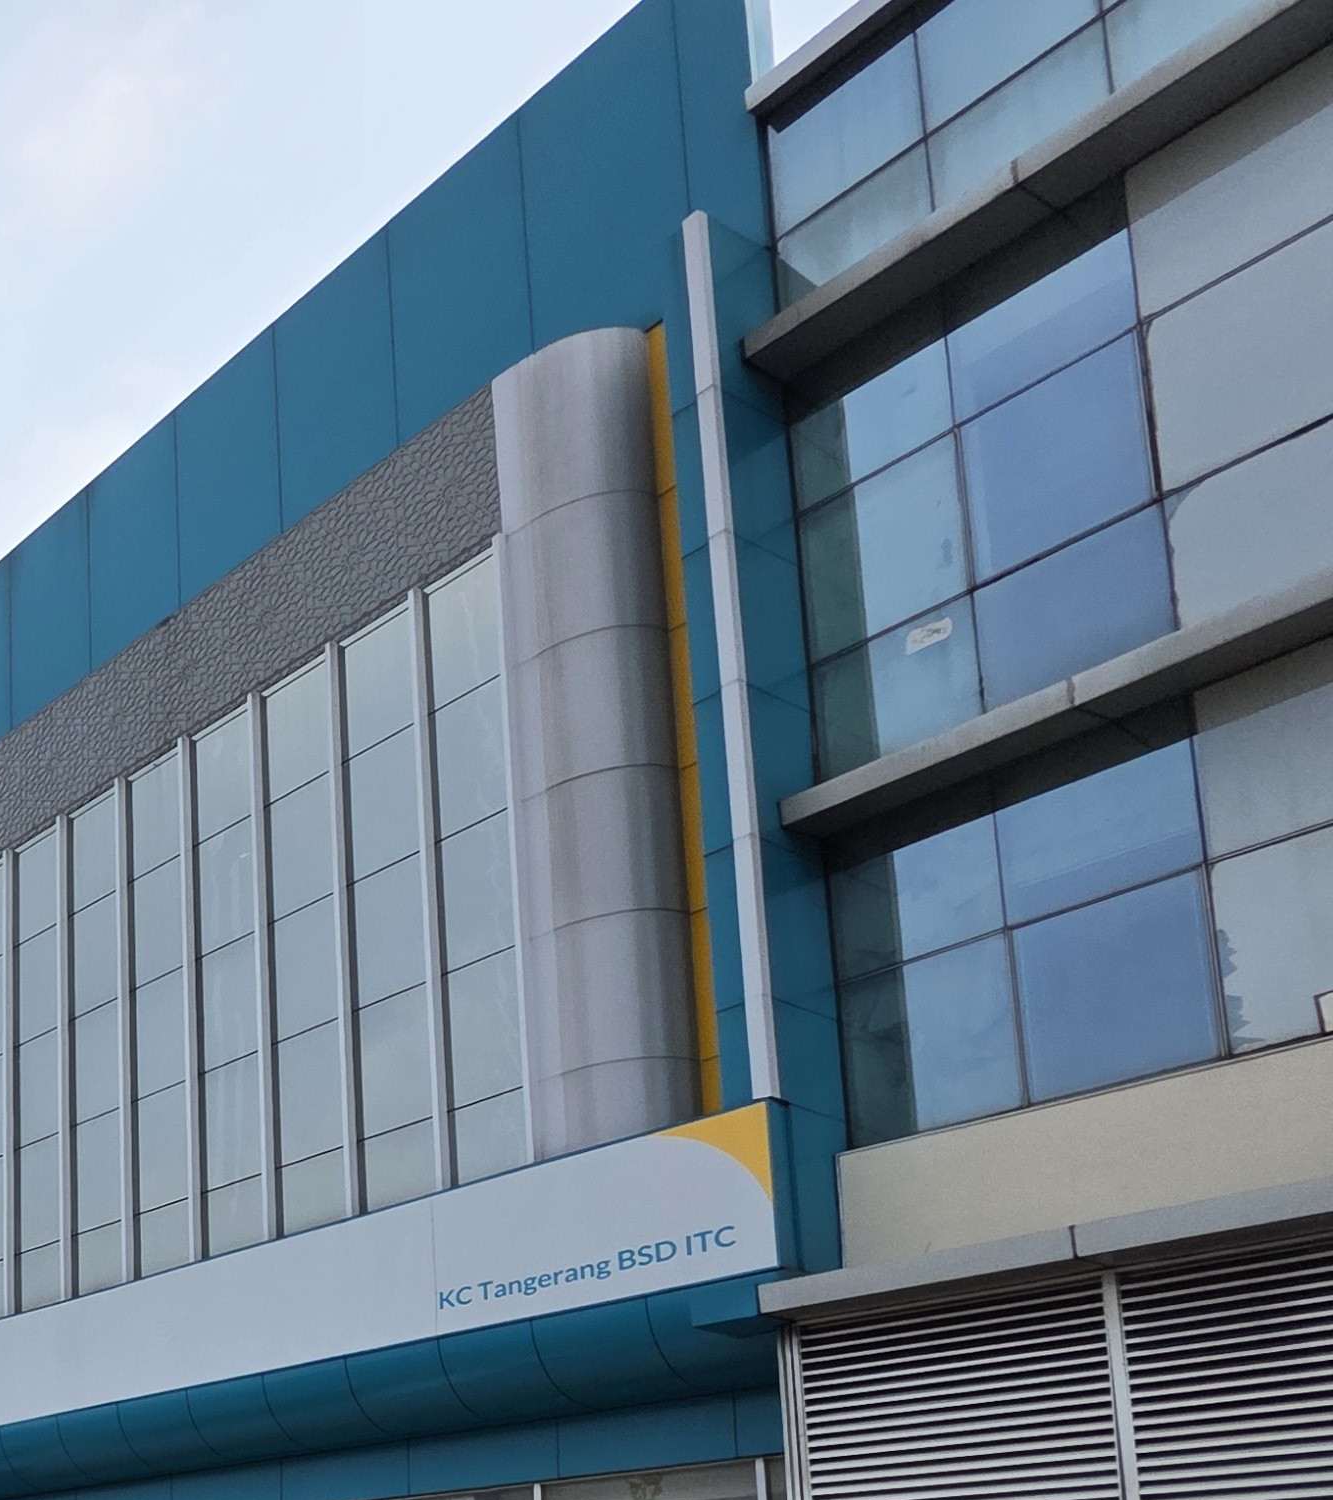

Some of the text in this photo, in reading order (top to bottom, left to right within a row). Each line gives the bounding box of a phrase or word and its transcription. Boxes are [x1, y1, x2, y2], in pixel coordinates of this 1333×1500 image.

[438, 1225, 737, 1311] KC Tangerang BSD ITC
